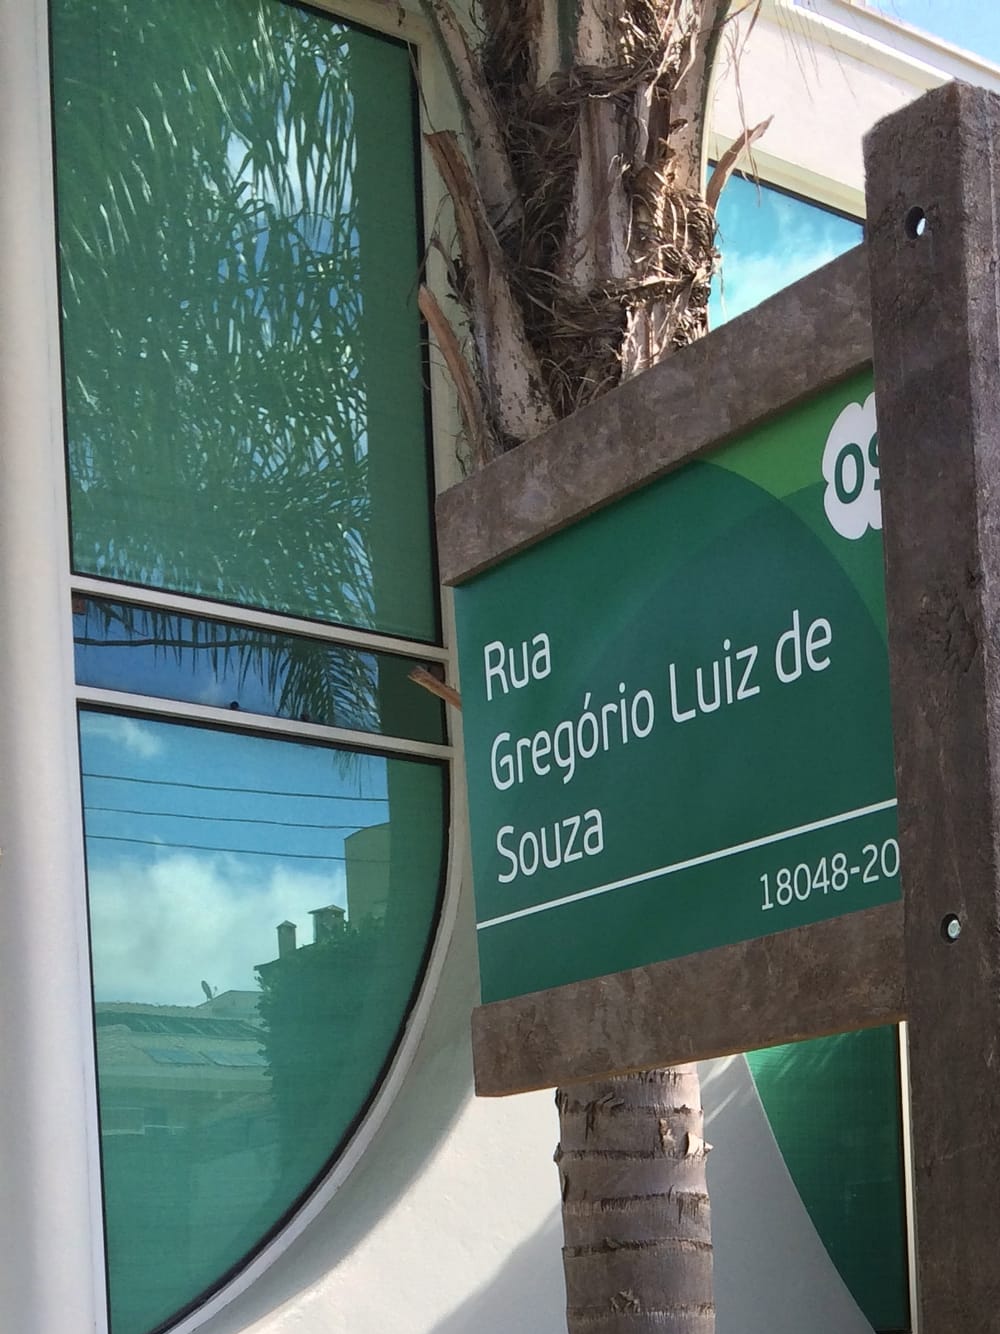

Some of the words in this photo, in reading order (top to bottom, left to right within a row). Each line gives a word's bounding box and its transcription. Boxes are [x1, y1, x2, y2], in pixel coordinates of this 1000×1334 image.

[485, 632, 551, 701] Rua
[491, 682, 654, 791] Gregório
[669, 638, 760, 723] Luiz
[775, 609, 832, 682] de
[496, 808, 604, 883] Souza
